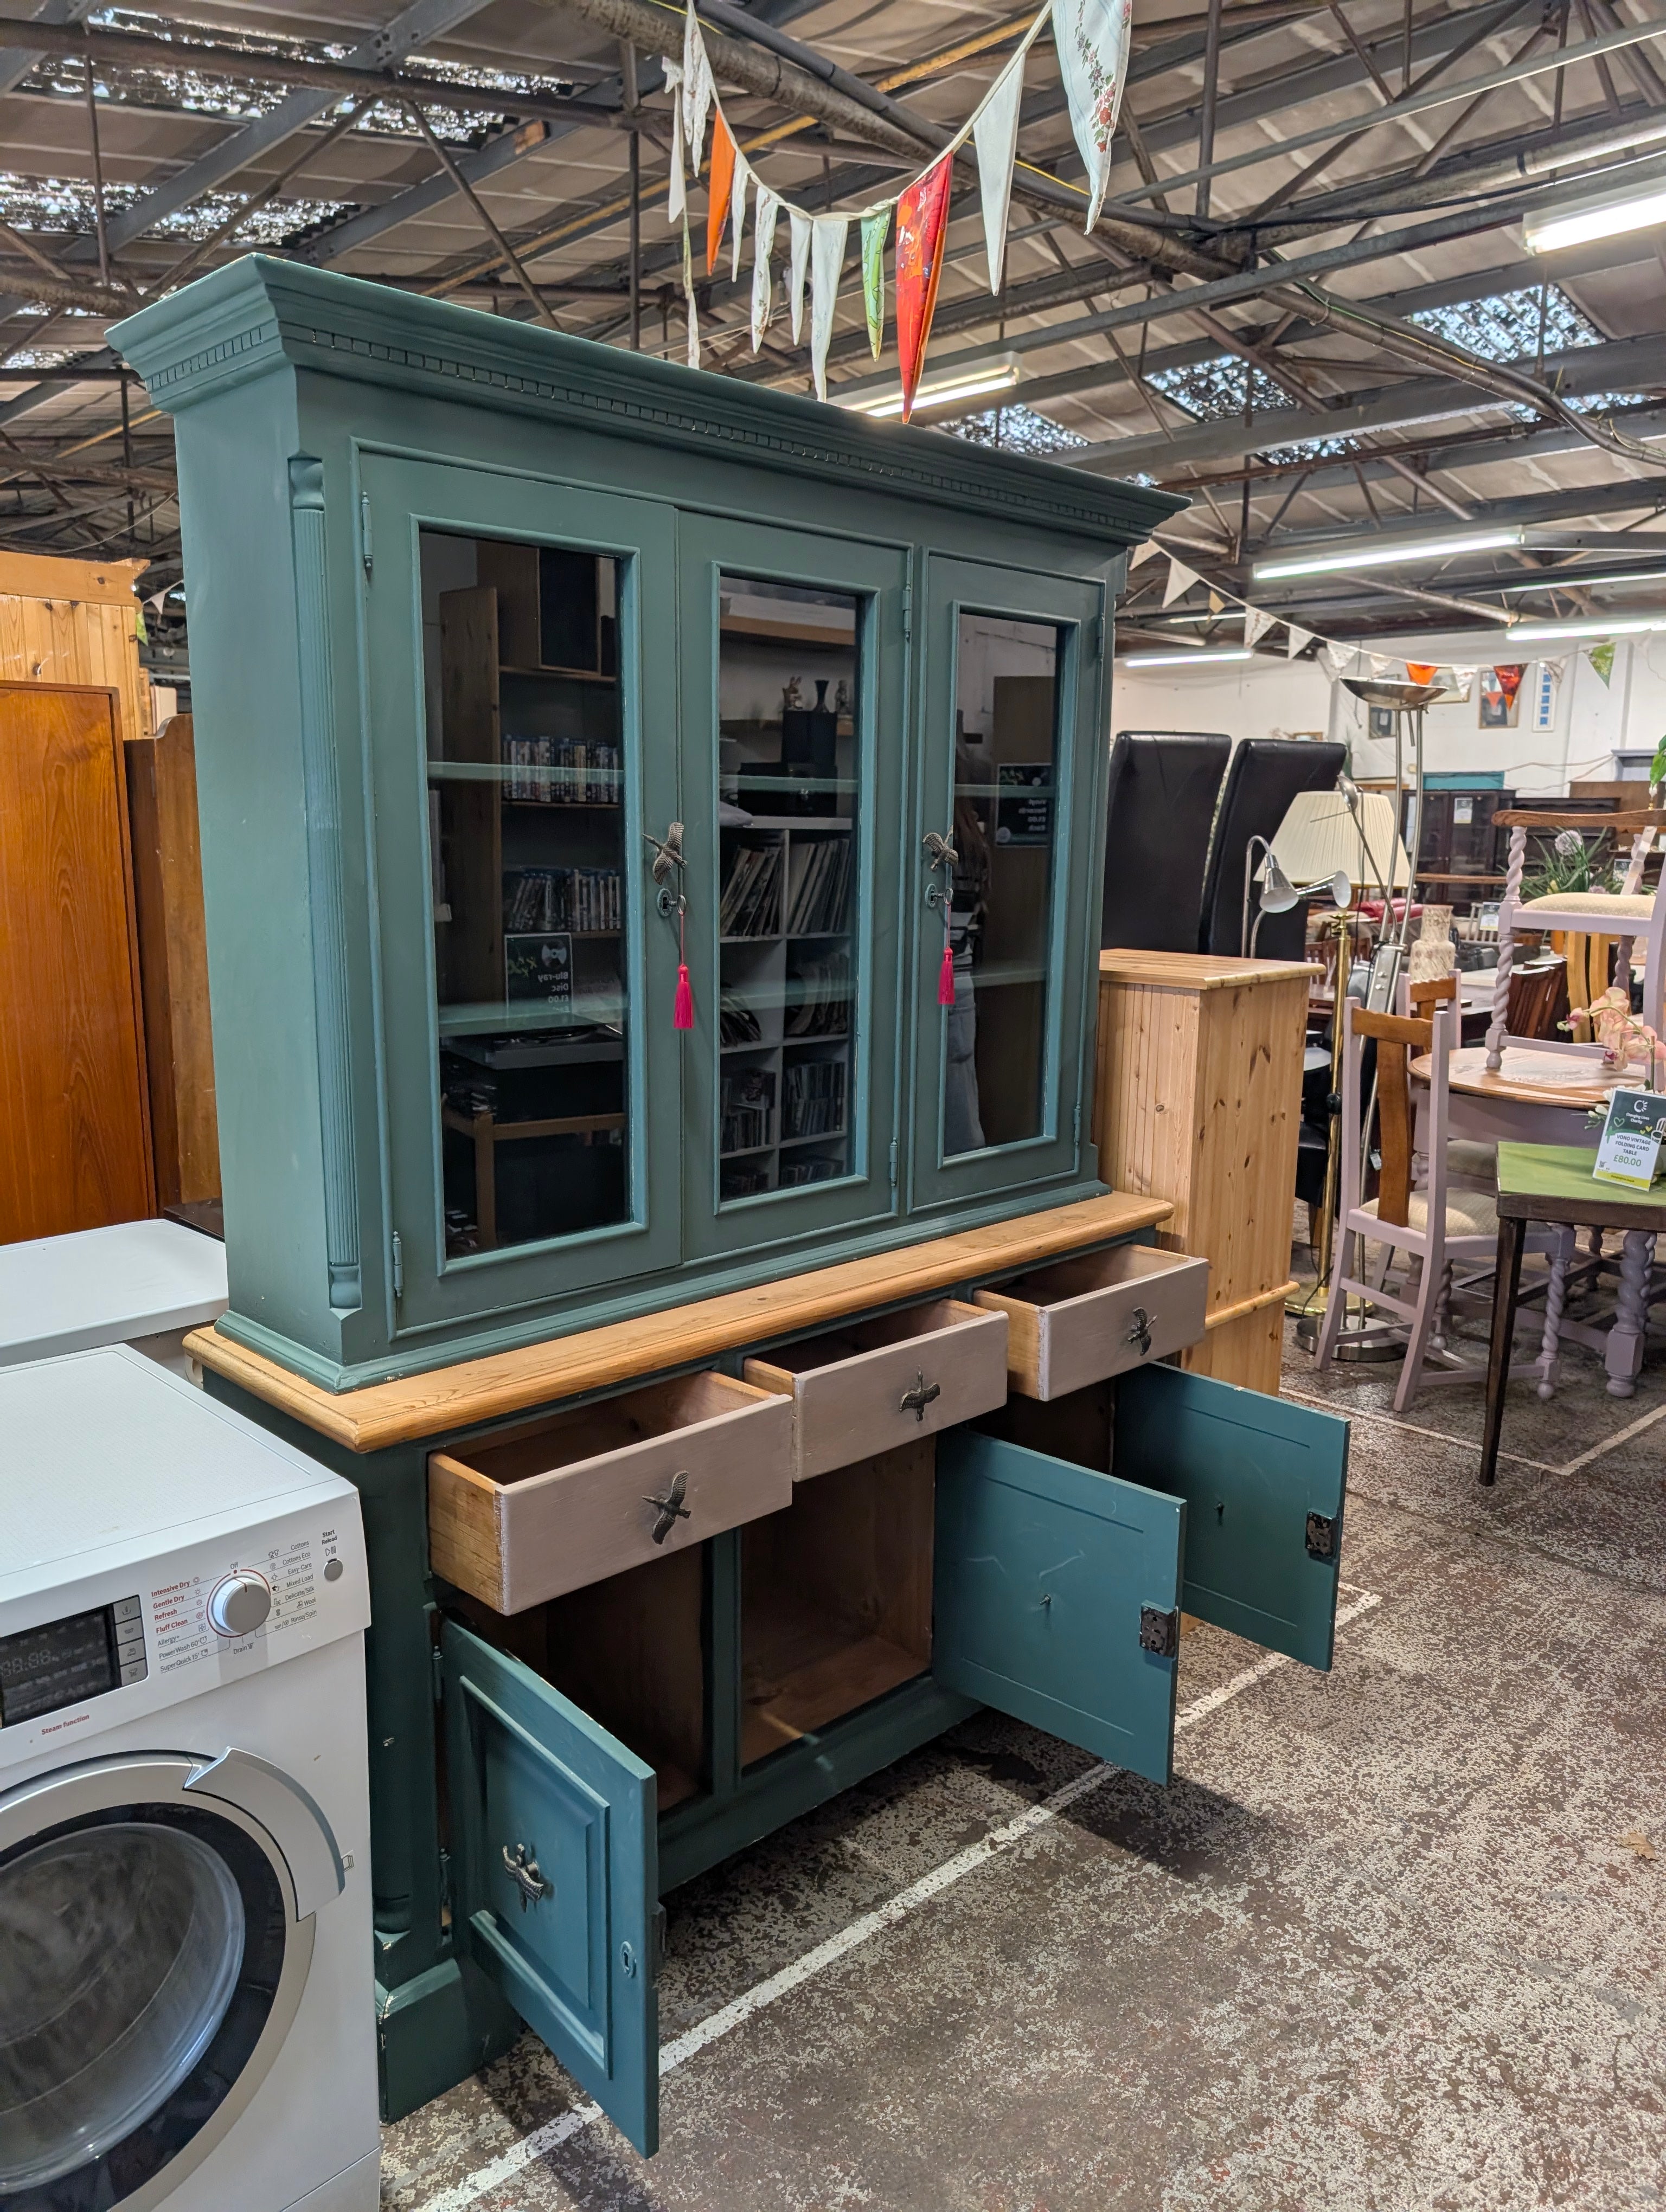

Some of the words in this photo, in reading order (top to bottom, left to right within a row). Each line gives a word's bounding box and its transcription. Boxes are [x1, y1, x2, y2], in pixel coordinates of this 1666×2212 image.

[1616, 1141, 1636, 1149] FOLDING
[1631, 1137, 1651, 1145] VINTAGE
[1613, 1154, 1642, 1167] £80.00
[322, 1529, 335, 1538] Start
[322, 1535, 337, 1545] Reload
[291, 1541, 309, 1551] Cottons
[282, 1555, 301, 1565] Cottons
[286, 1578, 301, 1587] Mixed
[302, 1573, 313, 1582] Load
[151, 1584, 178, 1597] Intensive
[285, 1586, 315, 1601] Delicate/Silk
[153, 1599, 173, 1609] Gentle
[304, 1597, 316, 1606] Wool
[155, 1609, 177, 1621] Refresh
[291, 1610, 317, 1623] Rinse/Spin
[156, 1624, 170, 1634] Fluff
[171, 1619, 188, 1628] Clean
[233, 1645, 247, 1654] Drain
[41, 1722, 62, 1735] Steam
[63, 1715, 89, 1727] function
